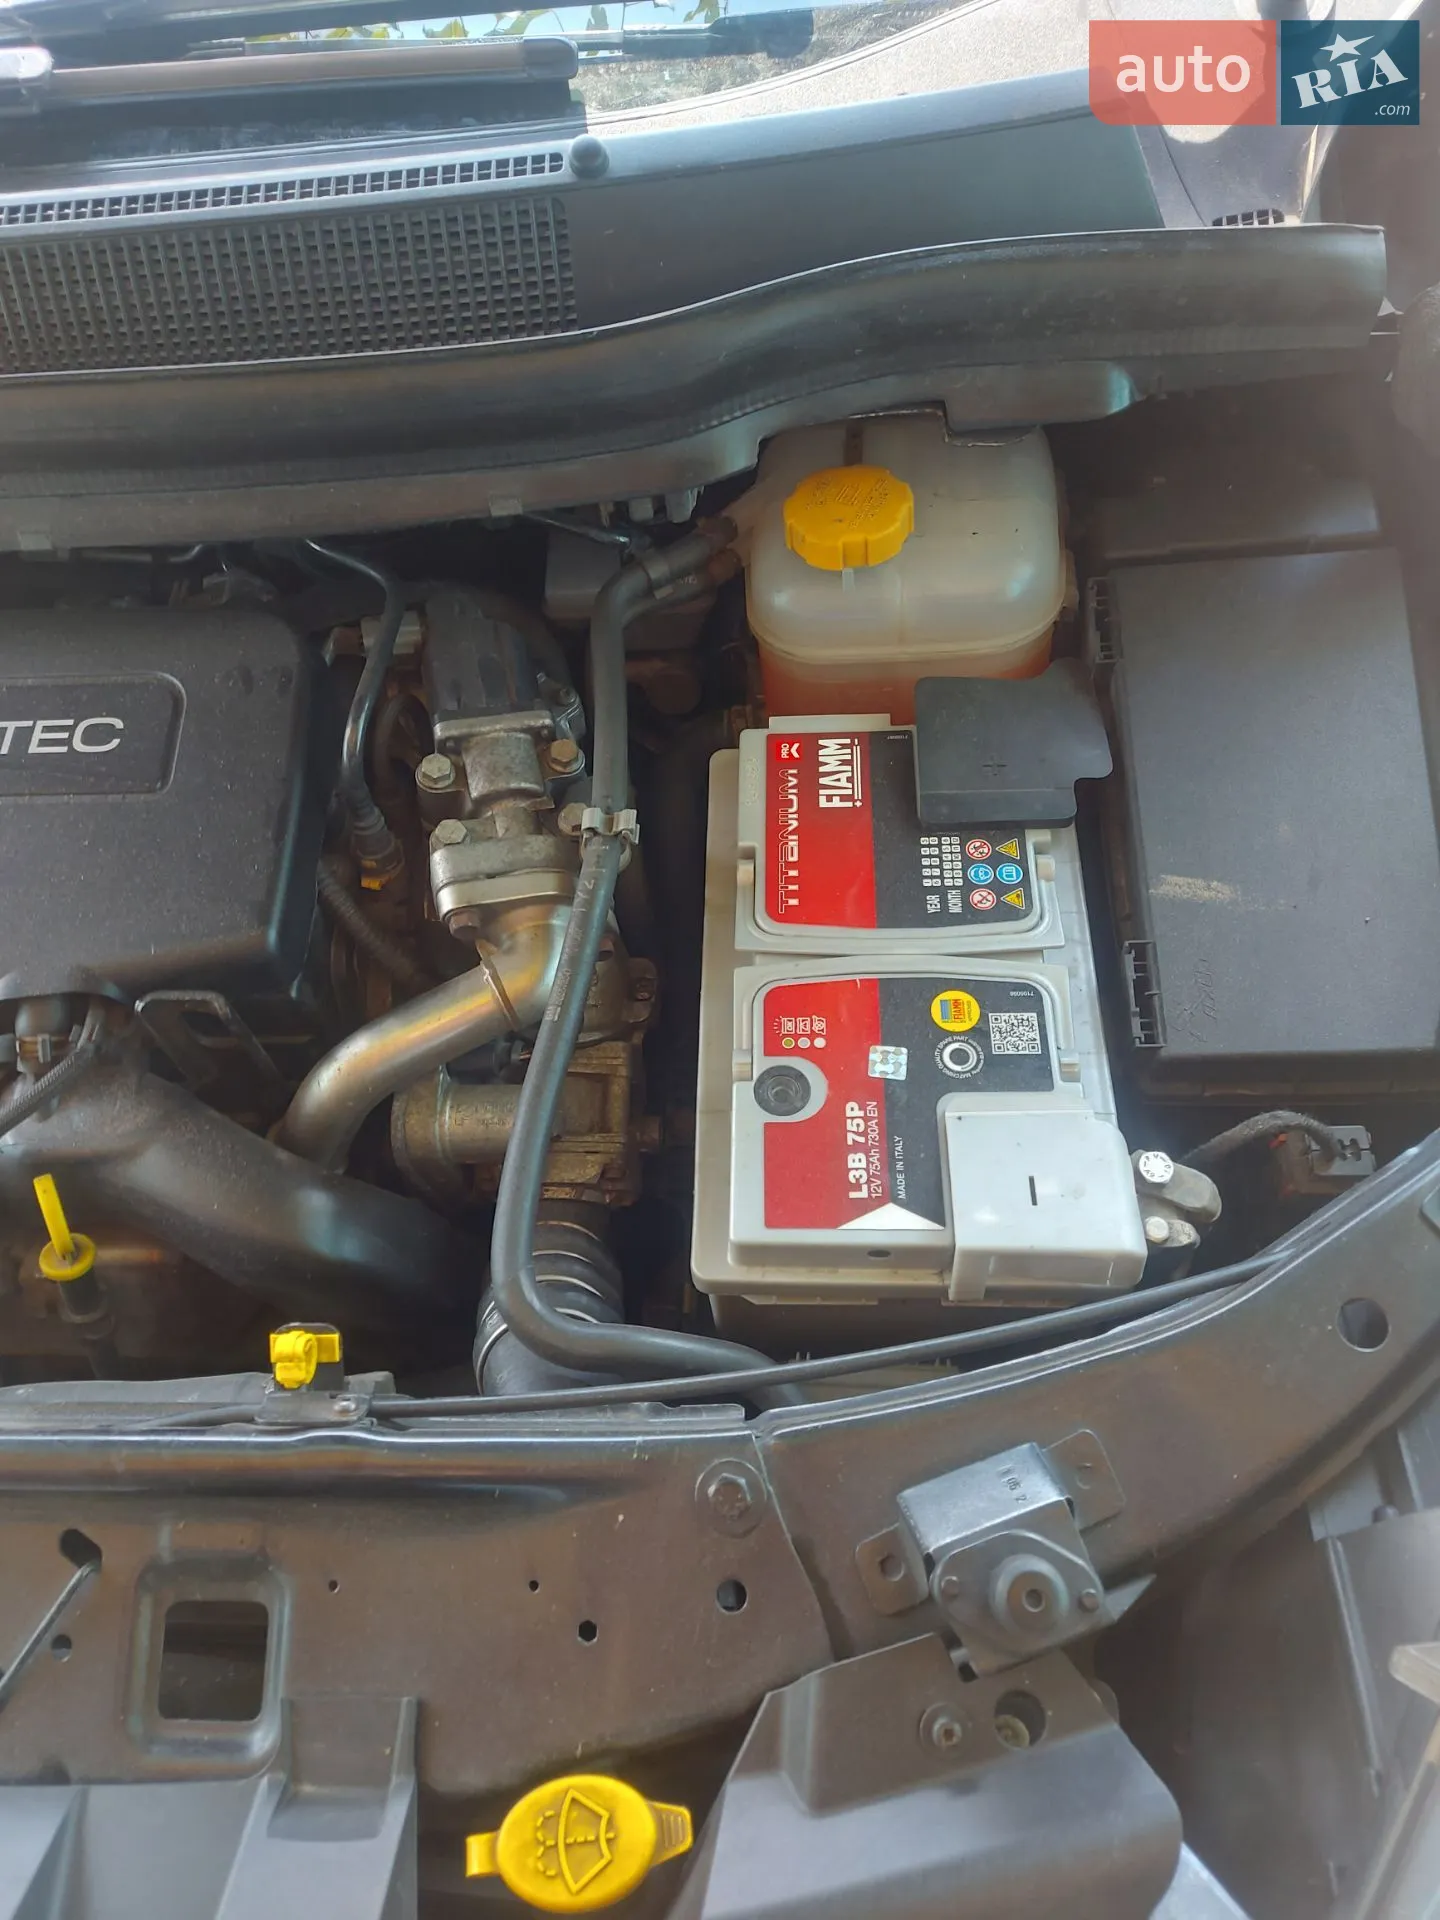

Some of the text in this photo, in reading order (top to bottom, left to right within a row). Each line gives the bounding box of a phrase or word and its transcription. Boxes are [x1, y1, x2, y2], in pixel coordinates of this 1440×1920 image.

[781, 744, 789, 758] PRO
[818, 738, 854, 808] FIAMM
[926, 895, 941, 913] YEAR
[947, 890, 962, 913] MONTH
[952, 999, 964, 1020] FIAMM
[846, 1102, 868, 1198] L3B 75P
[866, 1102, 882, 1199] 12V 75Ah 730A EN
[894, 1136, 906, 1199] MADE IN ITALY
